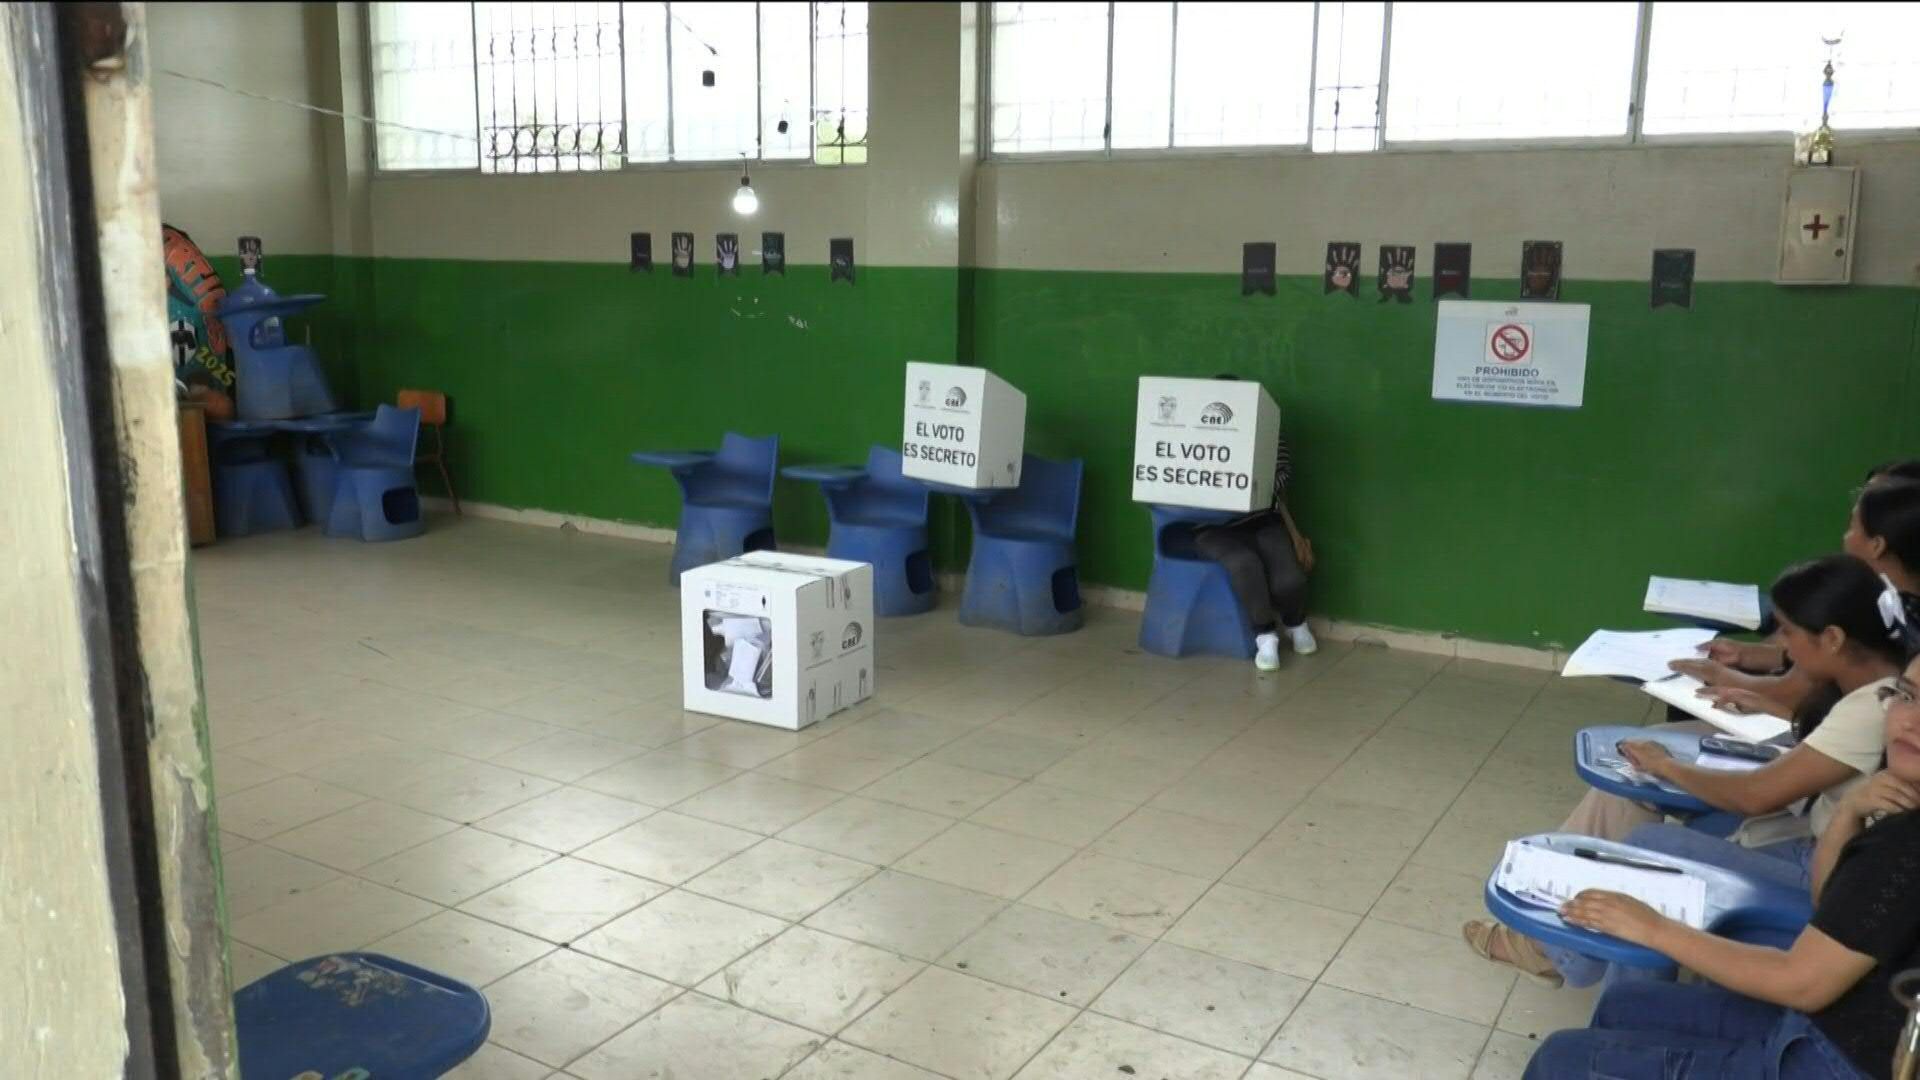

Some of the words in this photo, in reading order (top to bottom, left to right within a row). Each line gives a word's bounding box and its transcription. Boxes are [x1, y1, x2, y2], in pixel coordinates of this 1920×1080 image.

[196, 346, 236, 386] 2025
[1475, 366, 1540, 377] PROHIBIDO
[916, 421, 929, 438] EL
[932, 423, 965, 442] VOTO
[903, 442, 918, 458] ES
[920, 445, 976, 467] SECRETO
[1155, 441, 1176, 458] EL
[1180, 442, 1231, 463] VOTO
[1135, 464, 1158, 481] ES
[1163, 467, 1249, 490] SECRETO
